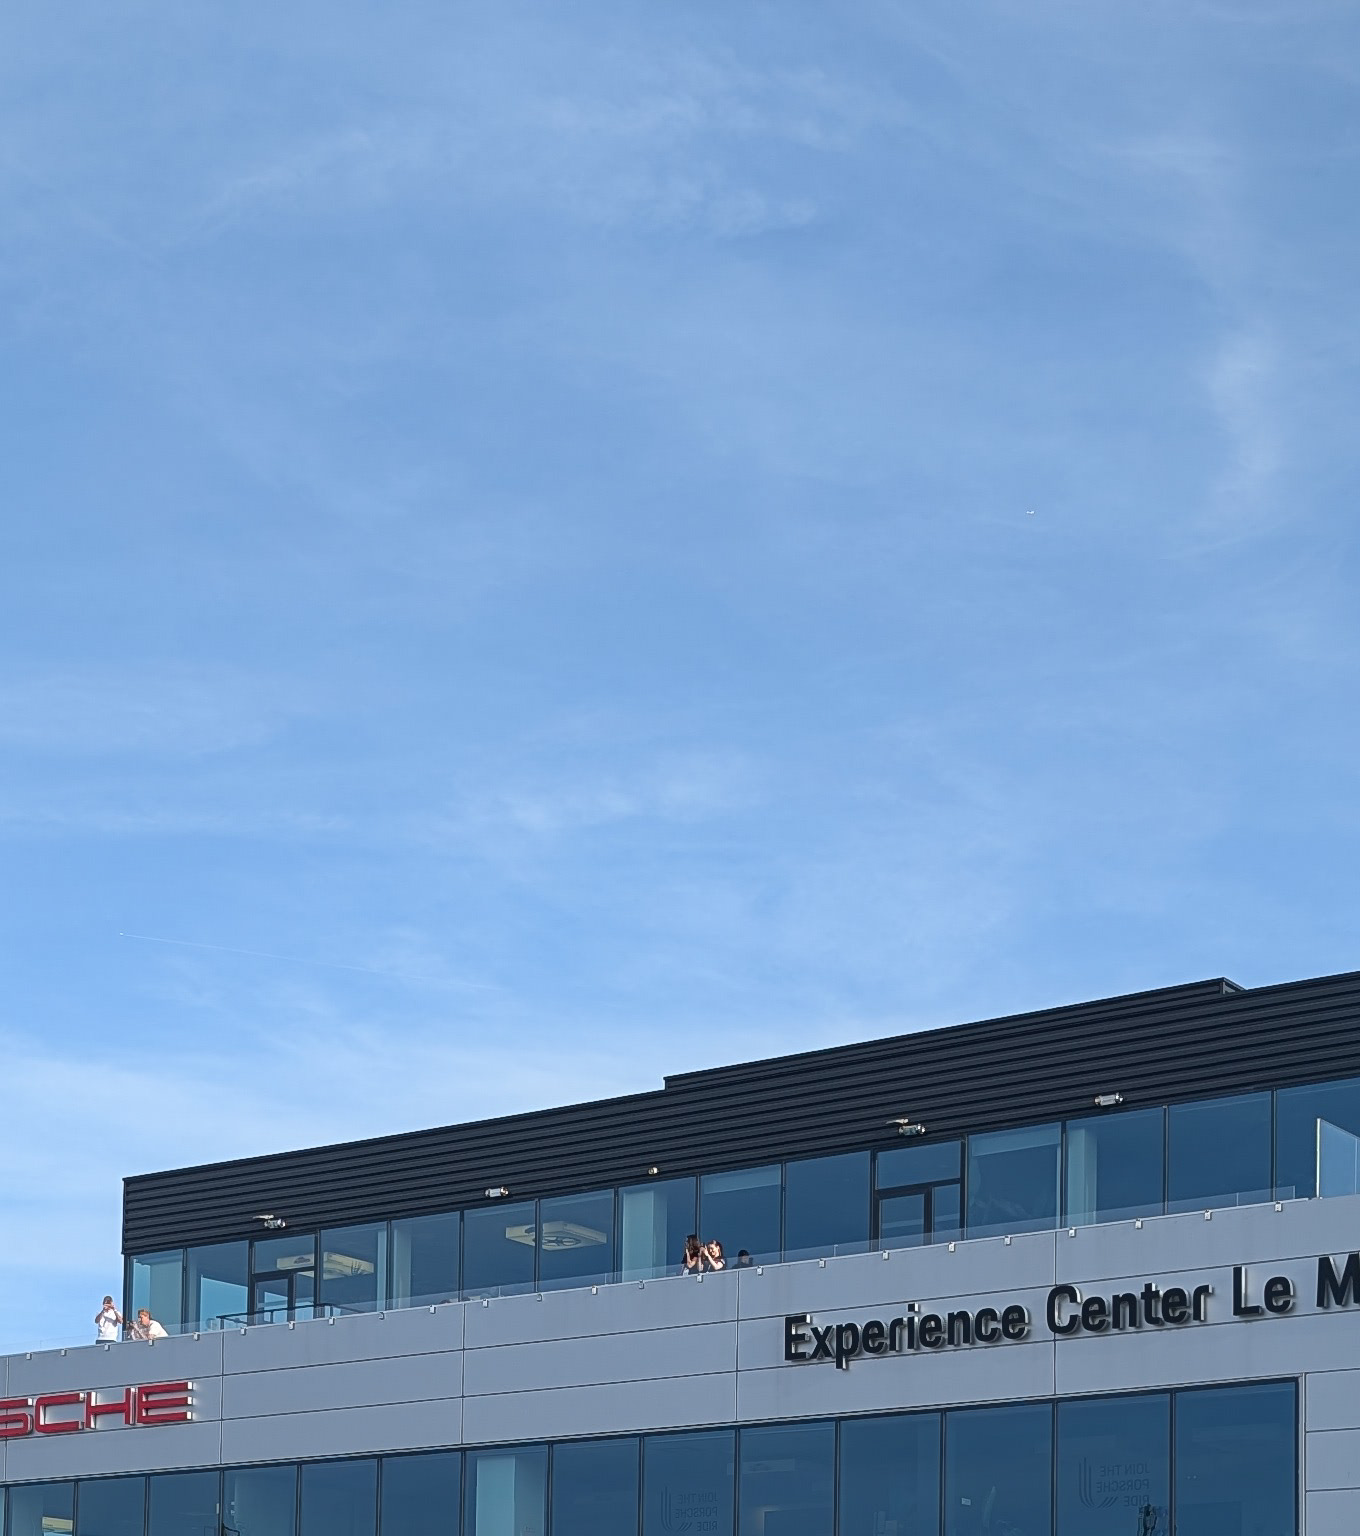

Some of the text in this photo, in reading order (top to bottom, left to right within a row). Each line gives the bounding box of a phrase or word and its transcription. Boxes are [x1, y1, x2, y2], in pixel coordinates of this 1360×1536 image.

[784, 1303, 1031, 1370] Experience
[1046, 1283, 1214, 1336] Center
[1232, 1265, 1296, 1317] Le
